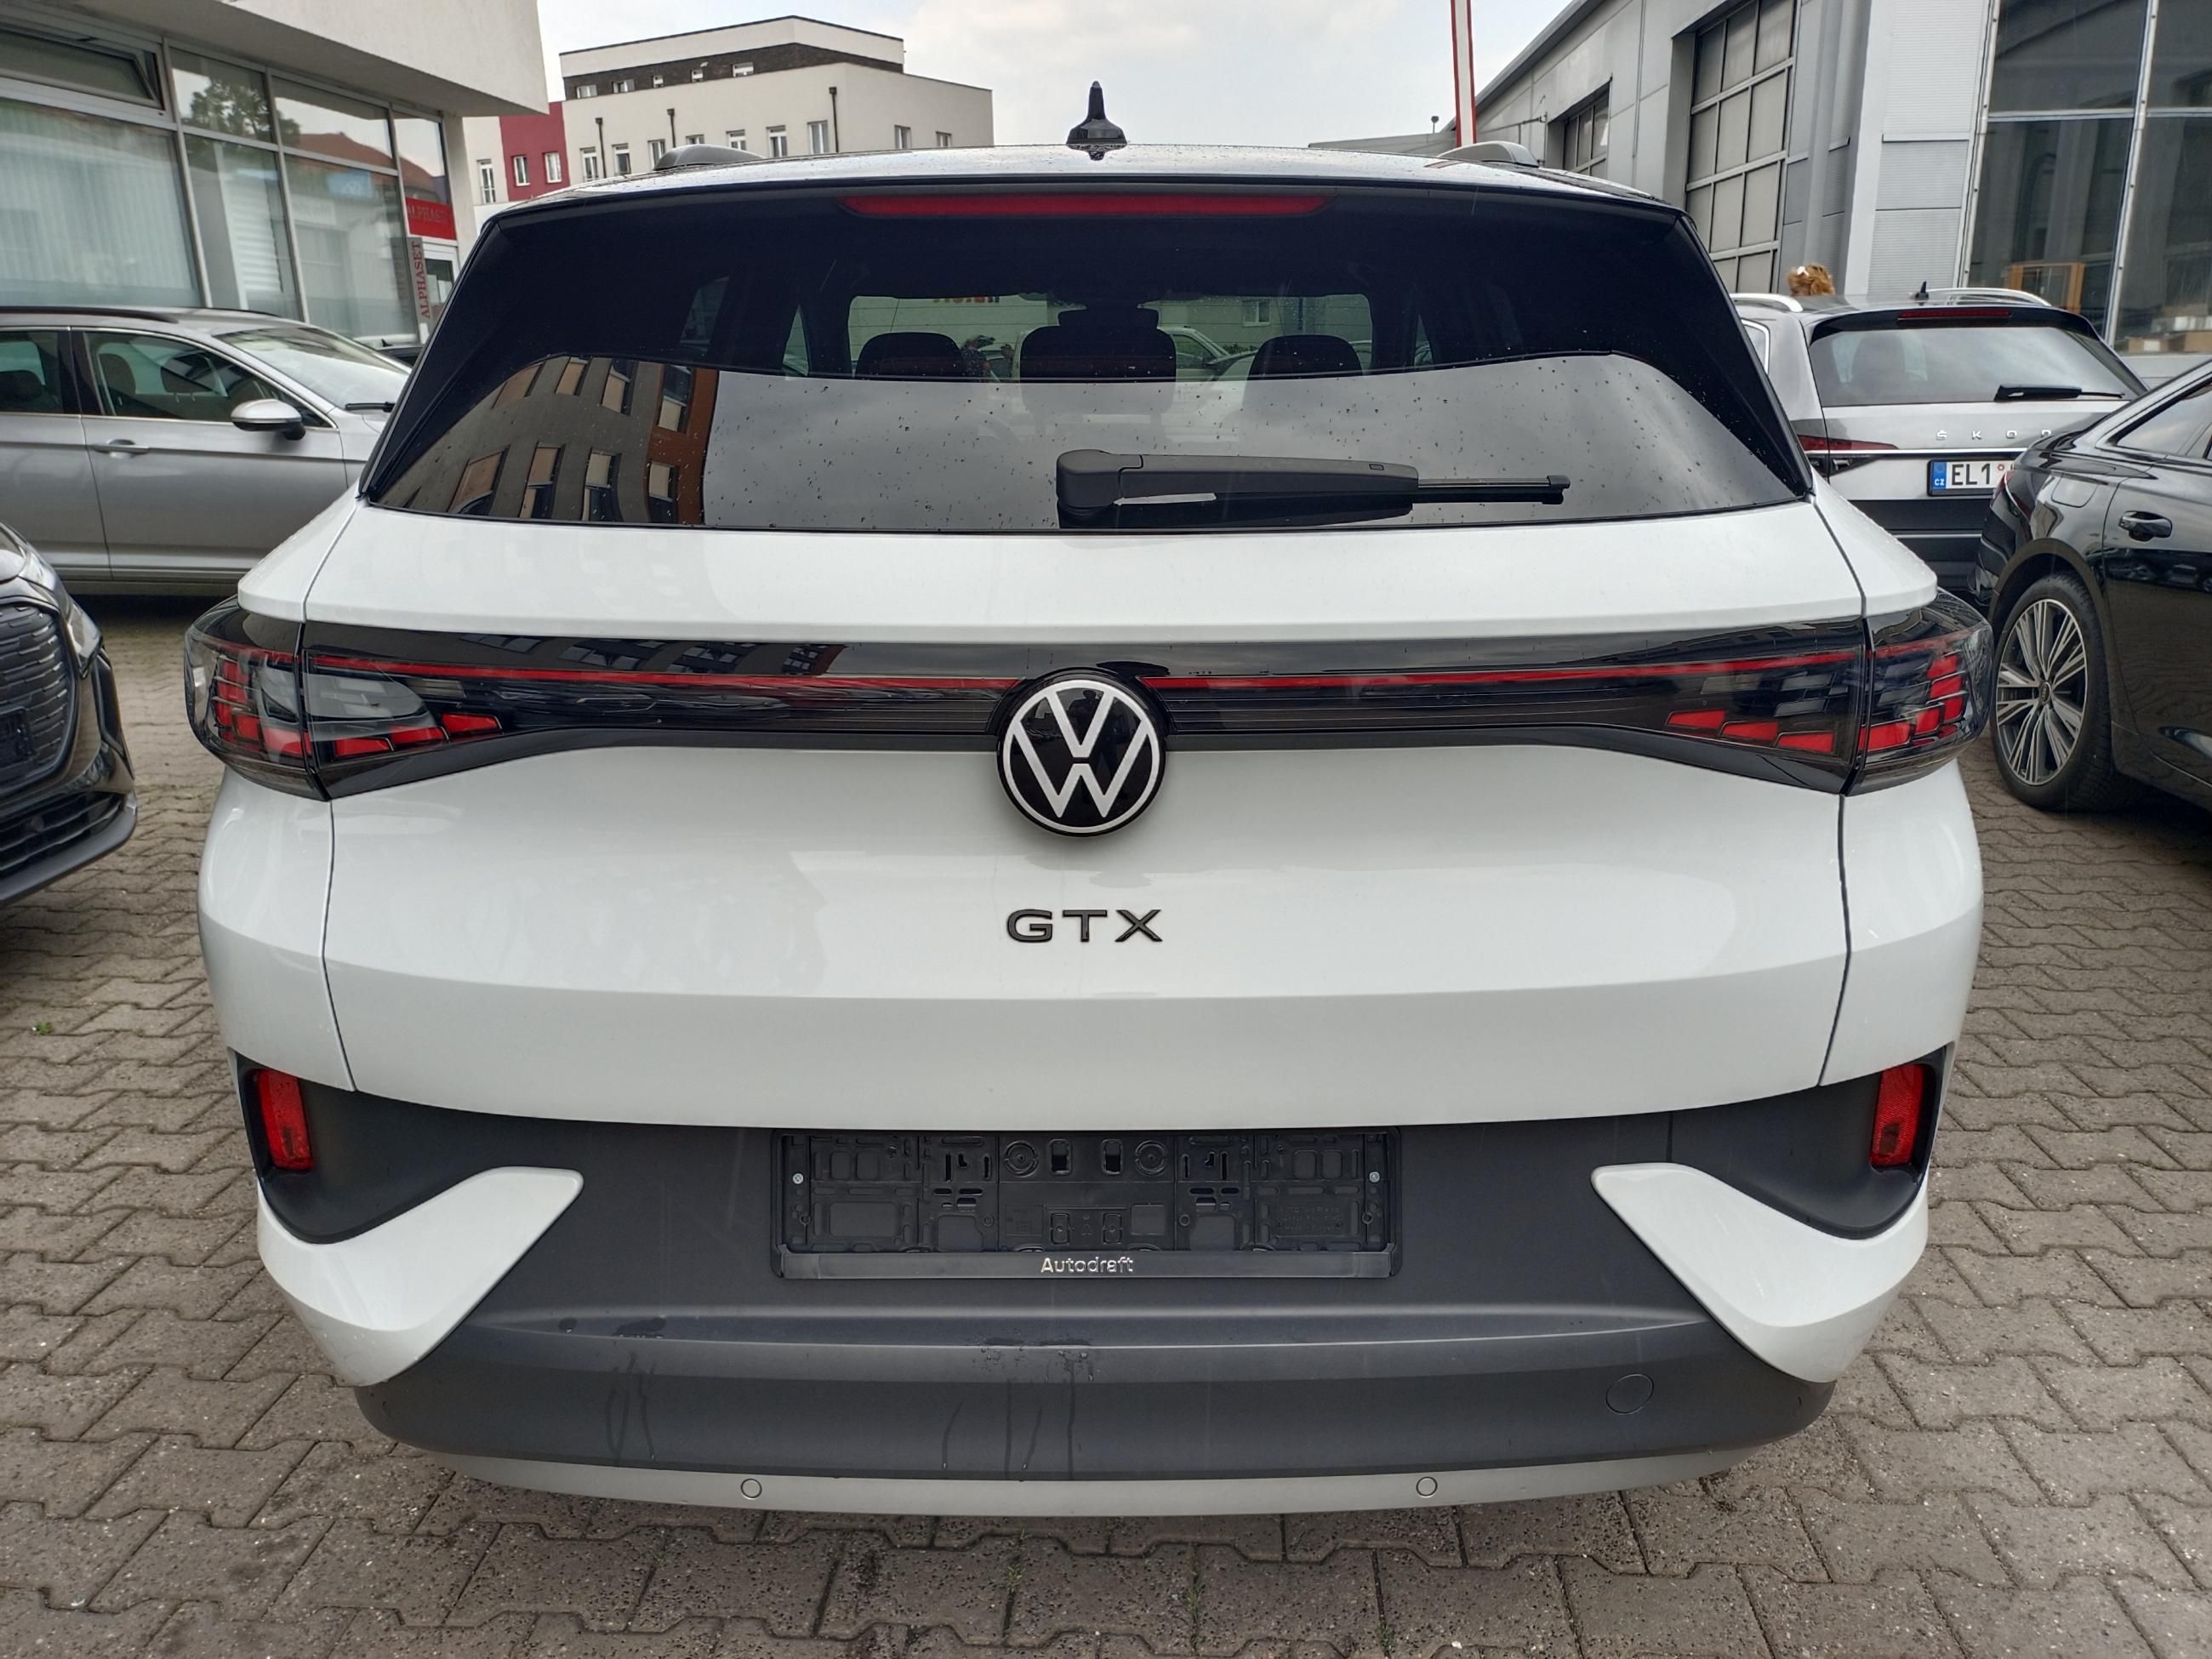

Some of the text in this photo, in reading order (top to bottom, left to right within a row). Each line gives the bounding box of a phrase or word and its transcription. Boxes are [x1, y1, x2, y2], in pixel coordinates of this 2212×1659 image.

[412, 241, 430, 319] ALPHASET
[1936, 430, 2051, 440] ŠKOD
[1952, 463, 1991, 486] EL1
[1006, 909, 1163, 943] GTX
[1040, 1257, 1133, 1273] Autodraft
